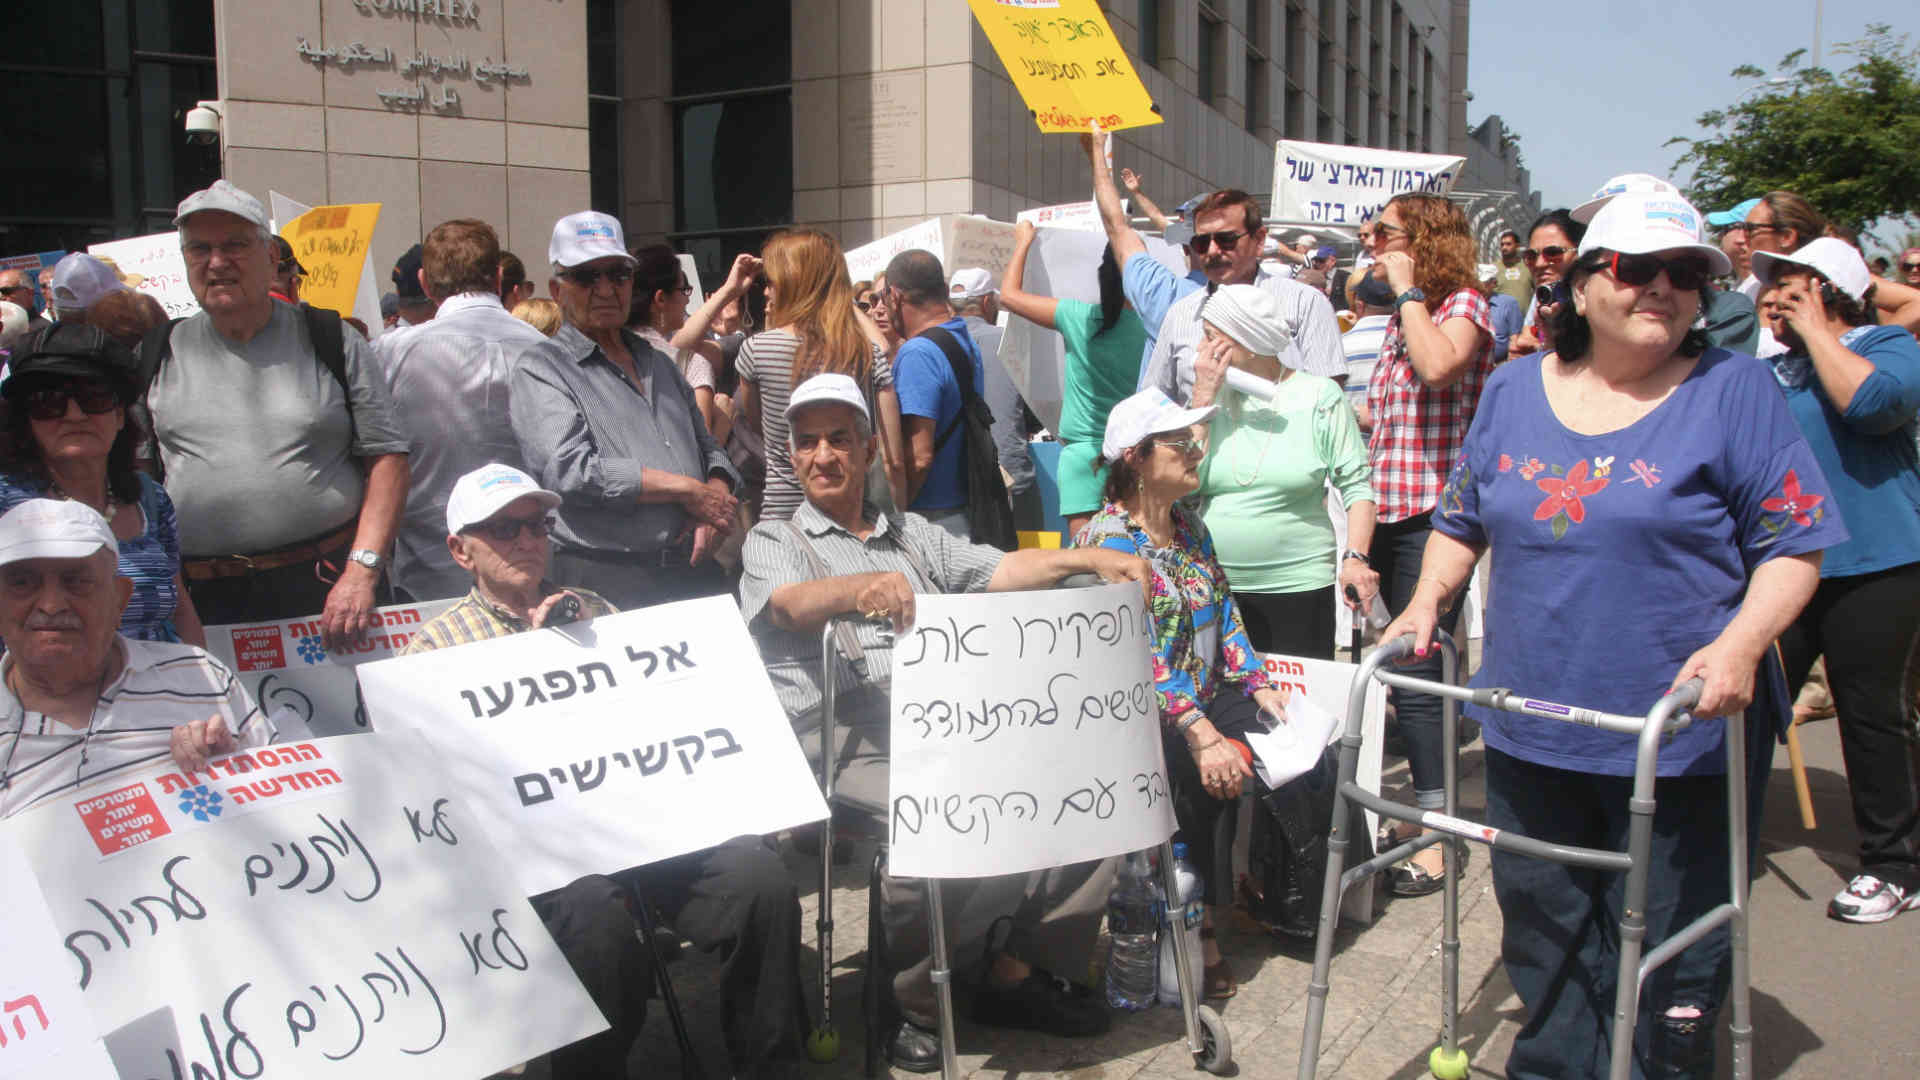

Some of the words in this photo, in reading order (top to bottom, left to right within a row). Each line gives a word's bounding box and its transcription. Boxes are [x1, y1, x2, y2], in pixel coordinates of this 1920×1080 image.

[353, 0, 480, 19] MPLEX
[1286, 156, 1314, 184] של
[1323, 162, 1384, 188] הארצי
[1391, 169, 1452, 195] הארגון
[624, 640, 697, 680] אל
[904, 616, 990, 667] את
[460, 661, 617, 720] תפגעו
[1075, 681, 1152, 729] שישים
[155, 743, 323, 795] ההסתדרות
[226, 768, 343, 805] החדשה
[513, 727, 744, 808] בקשישים
[1132, 772, 1168, 808] בד
[78, 786, 146, 815] מצטרפים
[403, 798, 458, 845] לא
[892, 791, 1038, 846] הקשיים
[1054, 777, 1118, 825] עם
[244, 813, 382, 902] נותנים
[64, 855, 207, 991] לחיות
[459, 909, 529, 975] לא
[286, 946, 447, 1062] נותנים
